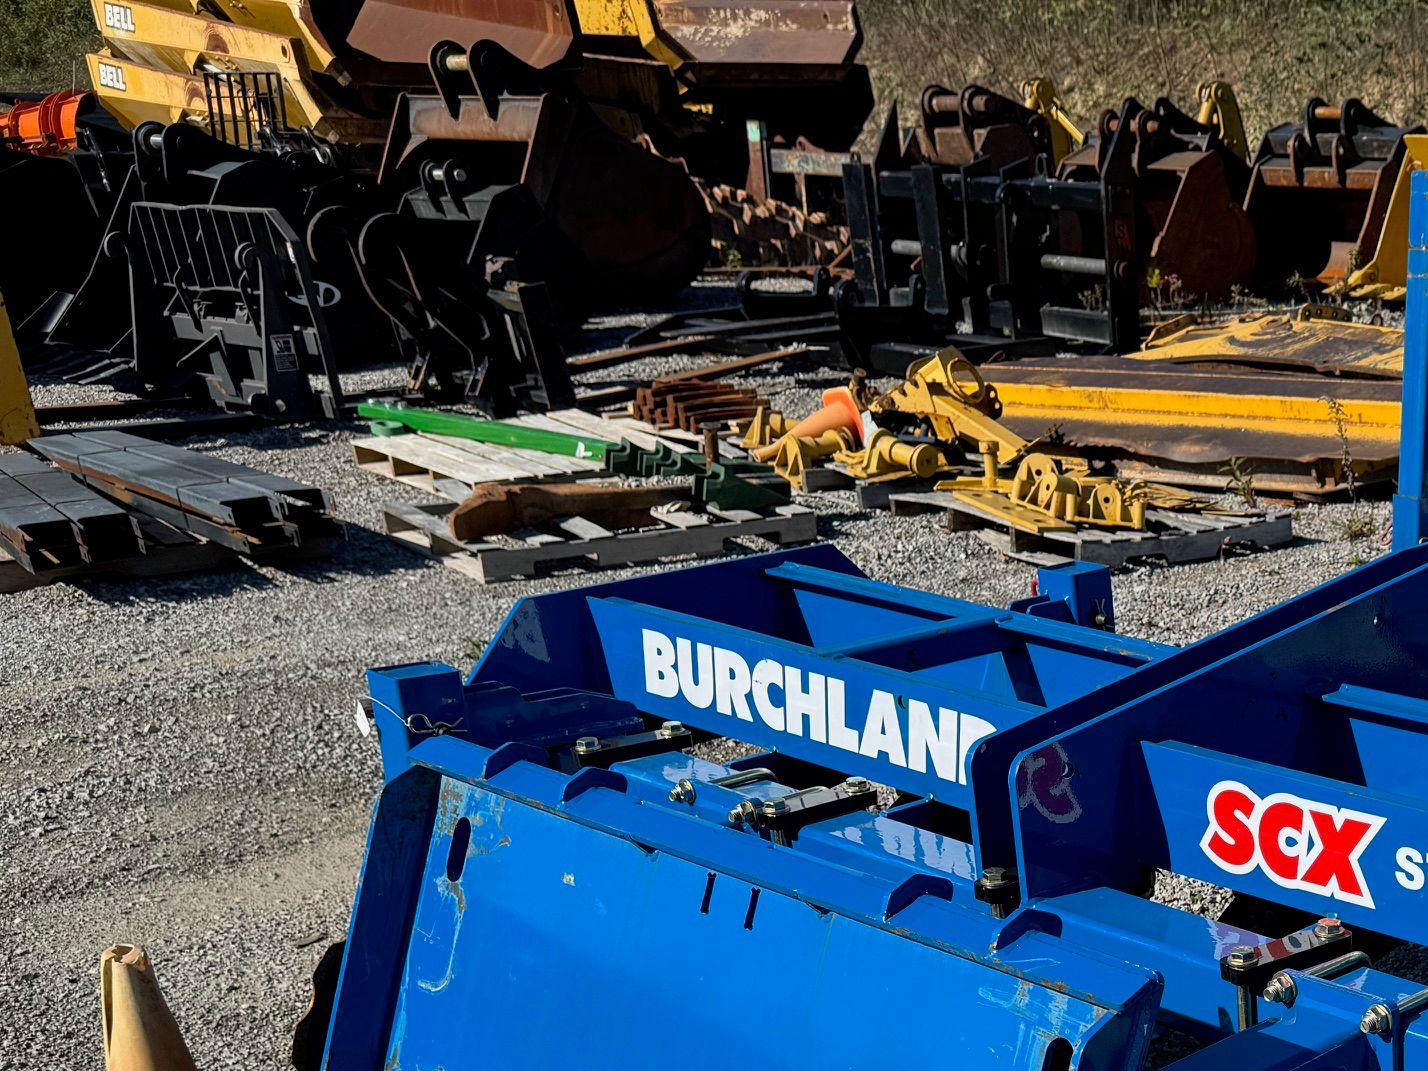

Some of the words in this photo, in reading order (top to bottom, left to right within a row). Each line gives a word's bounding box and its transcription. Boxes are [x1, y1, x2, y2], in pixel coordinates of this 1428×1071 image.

[104, 3, 136, 33] BELL
[98, 62, 126, 91] BELL
[1200, 780, 1387, 909] SCX
